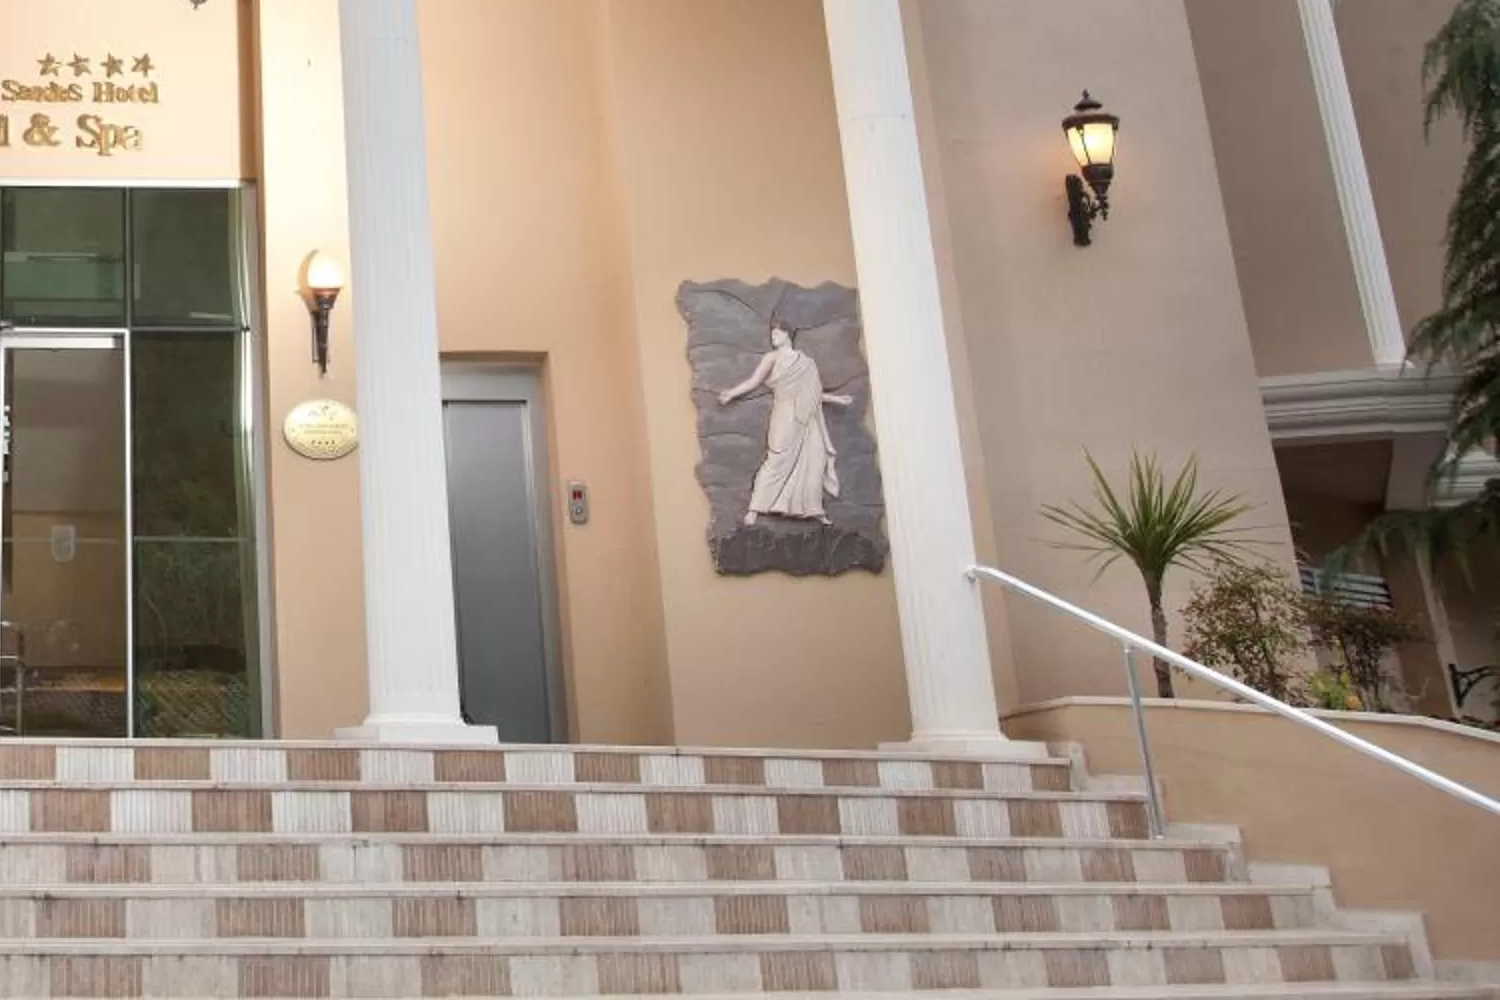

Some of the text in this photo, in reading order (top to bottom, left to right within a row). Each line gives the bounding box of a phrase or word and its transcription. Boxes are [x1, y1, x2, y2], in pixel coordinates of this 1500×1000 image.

[91, 80, 160, 104] Hotel
[22, 112, 61, 148] &
[75, 113, 145, 157] Spa
